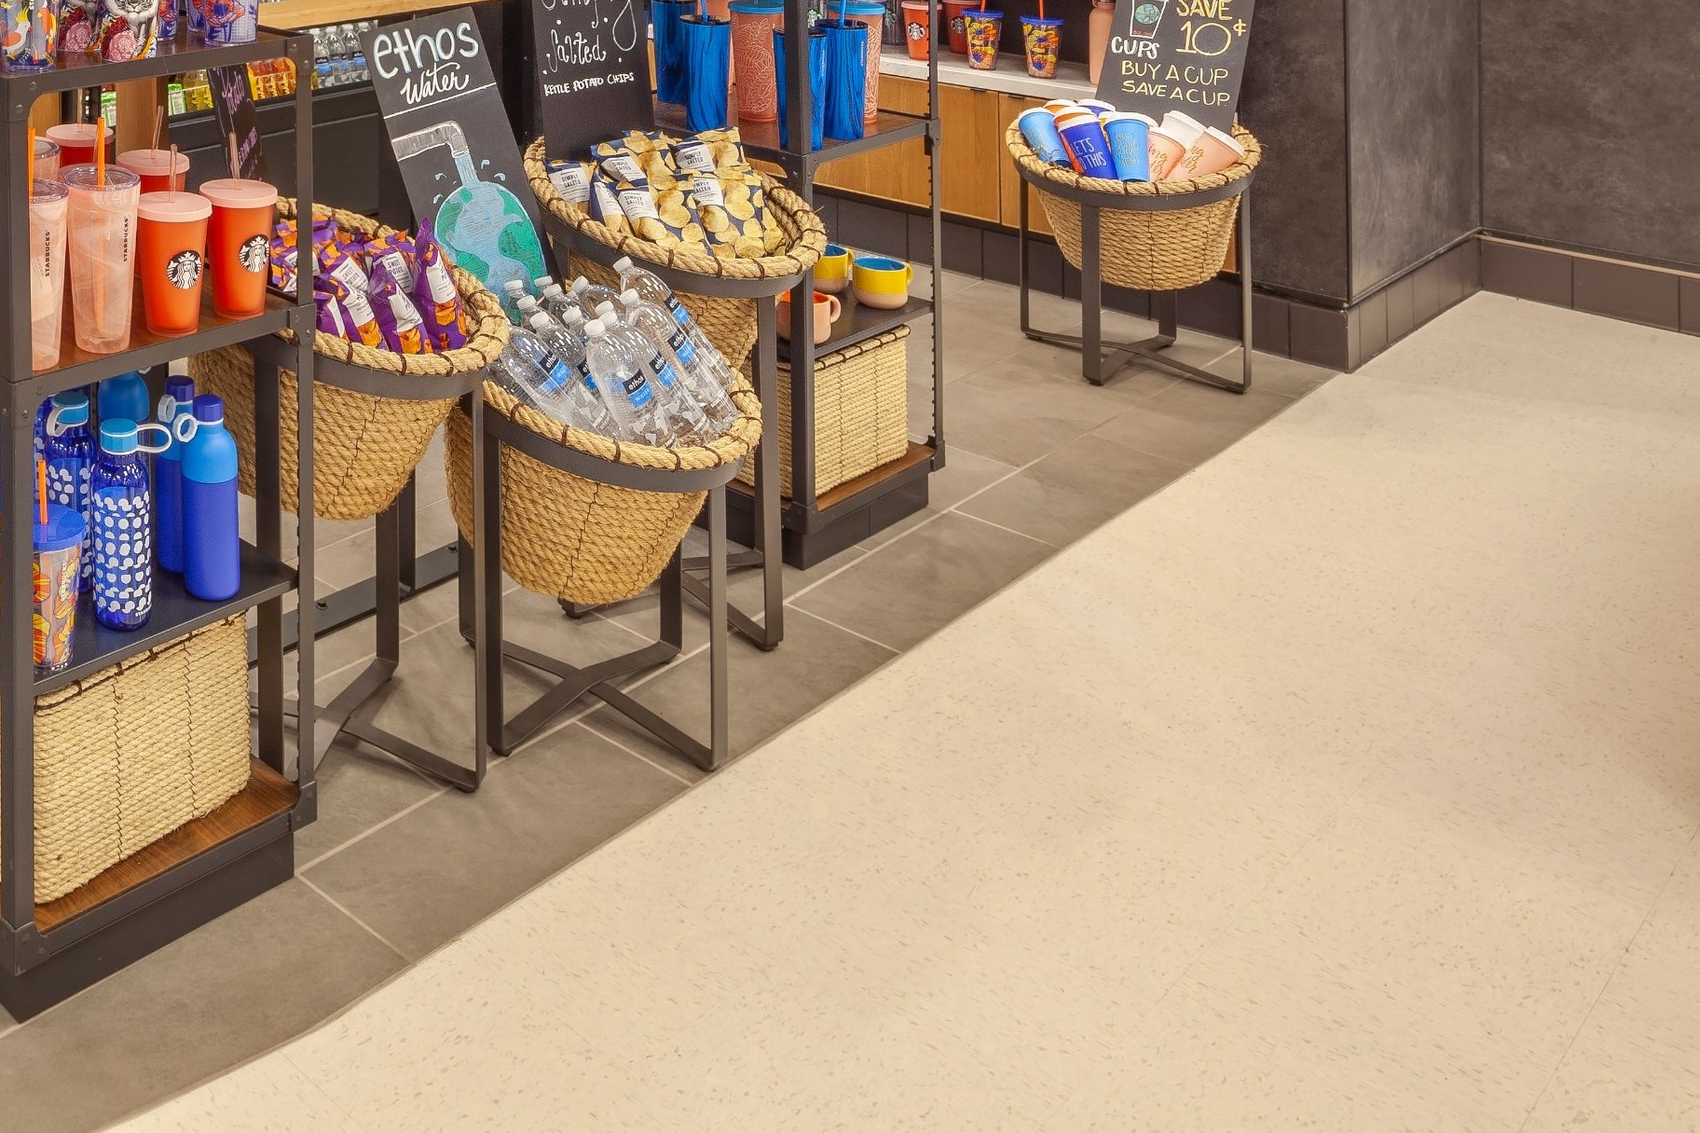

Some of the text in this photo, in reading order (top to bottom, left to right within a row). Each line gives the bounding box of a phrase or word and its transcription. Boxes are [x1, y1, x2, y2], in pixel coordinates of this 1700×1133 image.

[373, 22, 479, 79] ethos
[550, 28, 606, 72] Salted
[1111, 36, 1160, 59] CUPS
[400, 62, 469, 105] Water
[544, 72, 634, 96] KETTLE POTATO CHIPS
[1122, 60, 1228, 85] BUY A CUP
[1122, 81, 1183, 100] SAVE A
[1086, 152, 1107, 168] THIS
[628, 376, 644, 390] ethos
